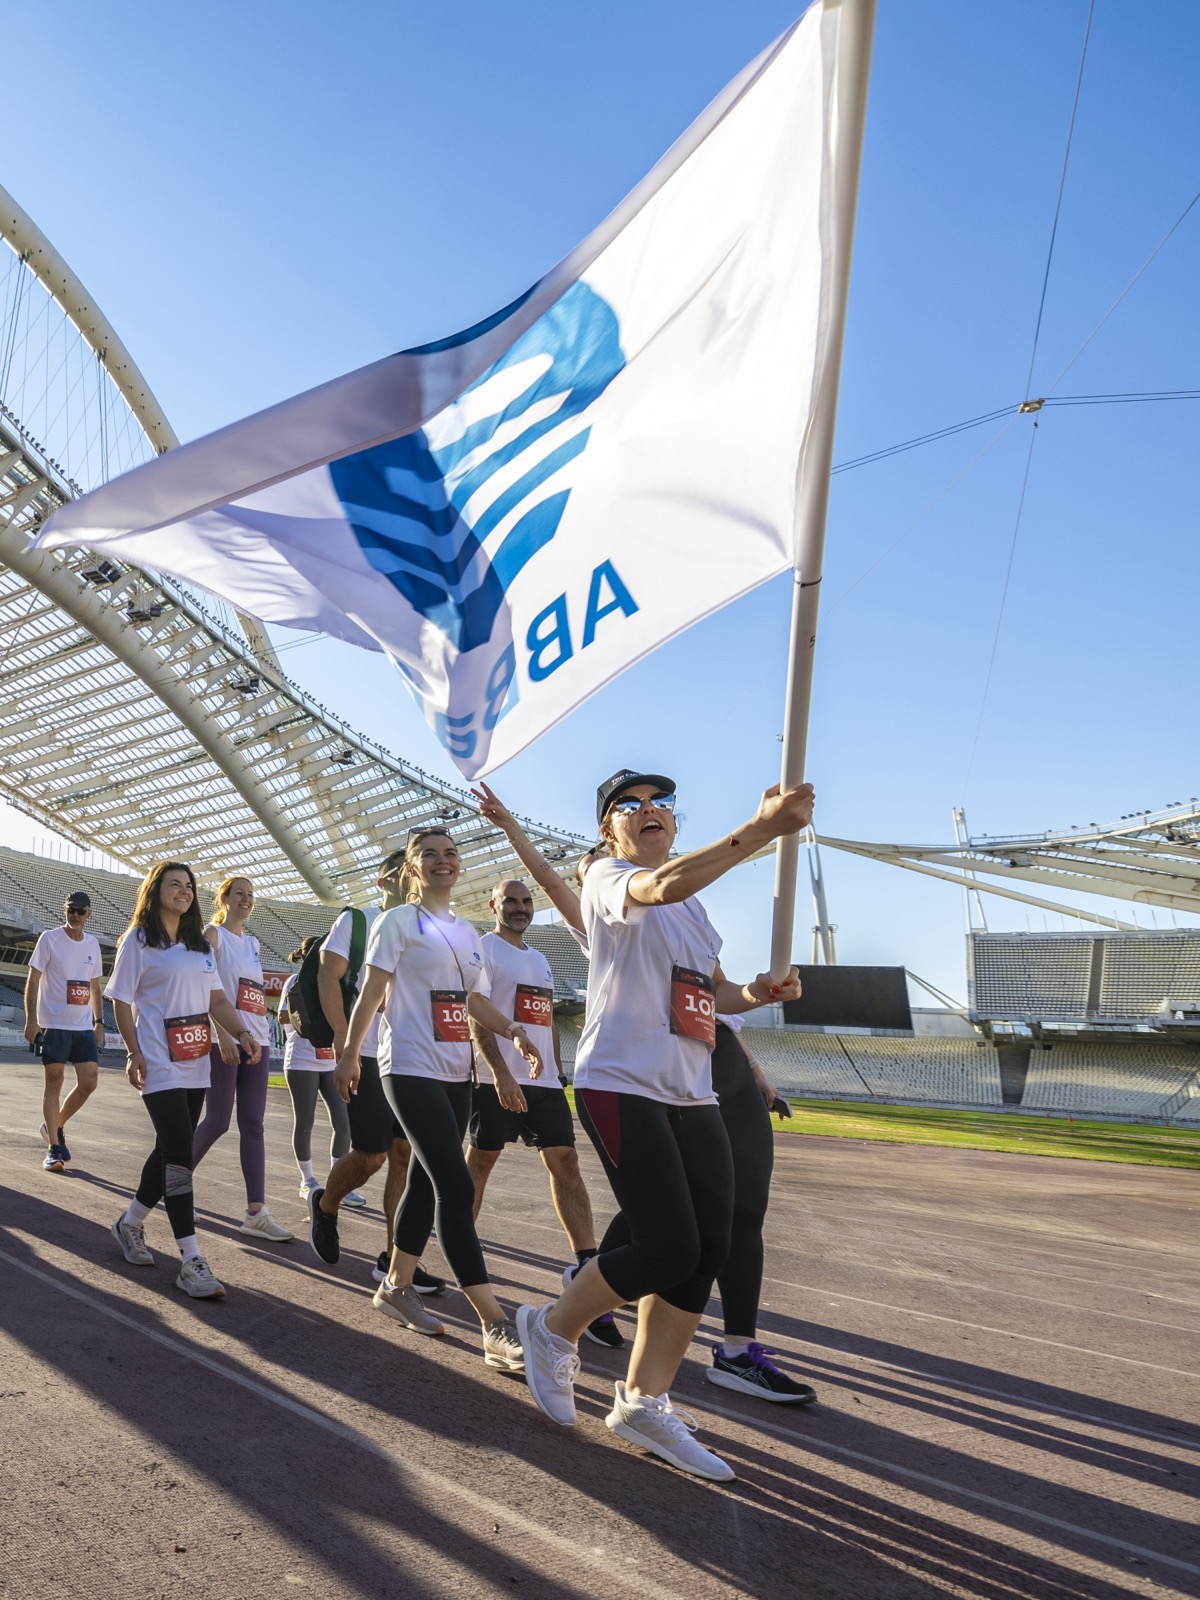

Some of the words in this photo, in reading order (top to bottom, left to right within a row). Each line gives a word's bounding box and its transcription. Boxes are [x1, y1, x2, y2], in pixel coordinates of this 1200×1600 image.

[71, 989, 89, 998] 1090
[243, 990, 265, 1005] 1093
[523, 1000, 551, 1013] 1096
[685, 993, 716, 1020] 108
[442, 1008, 468, 1023] 108
[175, 1029, 208, 1045] 1085
